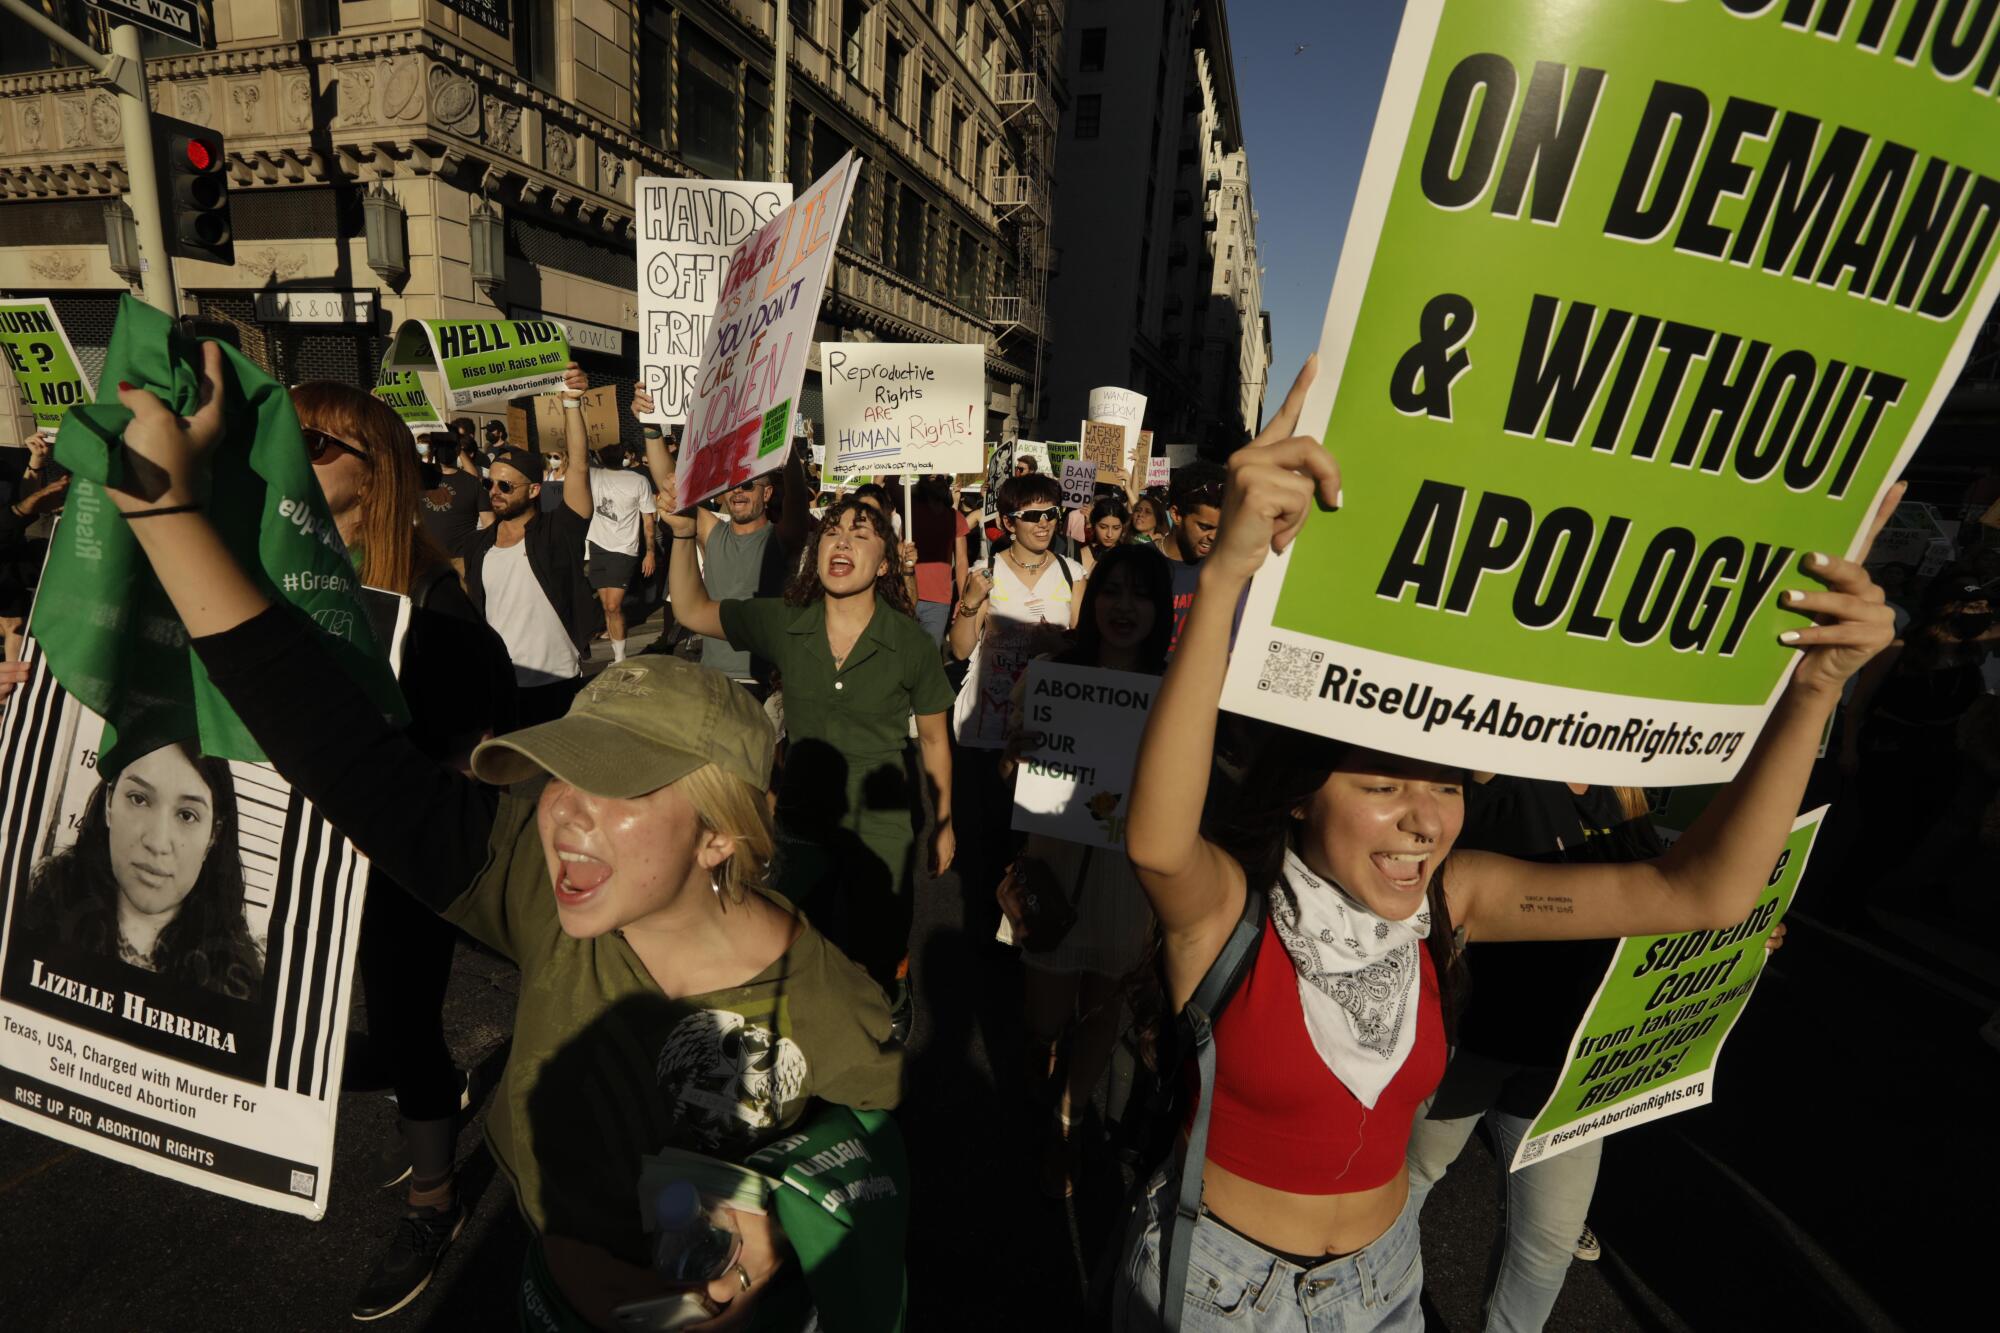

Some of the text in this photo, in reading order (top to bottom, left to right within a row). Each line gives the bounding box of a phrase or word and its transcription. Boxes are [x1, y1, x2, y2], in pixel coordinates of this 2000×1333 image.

[146, 1, 184, 26] WAY
[1420, 52, 2000, 323] ON DEMAND
[645, 186, 781, 247] HANDS
[647, 251, 715, 302] OFF
[309, 299, 320, 318] &
[709, 314, 752, 364] YOU
[751, 276, 806, 338] DON'T
[438, 323, 512, 359] HELL
[514, 321, 561, 346] NO!
[462, 351, 561, 379] Rise Up! Raise Hell!
[700, 330, 767, 398] CARE IF
[829, 350, 935, 392] Reproductive
[40, 380, 84, 405] NO!
[407, 389, 428, 406] NO!
[687, 331, 793, 461] WOMEN
[875, 385, 923, 409] Rights
[1103, 391, 1133, 401] WANT
[1389, 293, 1908, 500] & WITHOUT
[839, 425, 900, 452] HUMAN
[908, 404, 974, 444] Rights!
[864, 406, 893, 422] ARE
[1086, 425, 1121, 438] UTERUS
[857, 463, 873, 474] your
[906, 461, 918, 471] my
[1066, 465, 1096, 479] BANS
[1085, 451, 1118, 465] WHITE
[1064, 479, 1090, 492] OFF
[1375, 480, 1795, 657] APOLOGY
[1033, 678, 1149, 710] ABORTION
[1033, 704, 1052, 723] IS
[1318, 664, 1745, 764] RiseUp4AbortionRights.org
[1032, 731, 1076, 754] OUR
[1027, 759, 1096, 786] RIGHT!
[1644, 950, 1745, 1011] Court
[1575, 1023, 1634, 1060] from
[1637, 998, 1708, 1039] taking
[1577, 1013, 1719, 1087] Abortion
[3, 1016, 257, 1114] Texas, USA, Charged with Murder For
[1576, 1047, 1690, 1113] Rights!
[49, 1056, 197, 1119] Self Induced Abortion
[15, 1086, 215, 1167] RISE UP FOR ABORTION RIGHTS
[1550, 1082, 1705, 1146] RiseUp4AbortionRights.org
